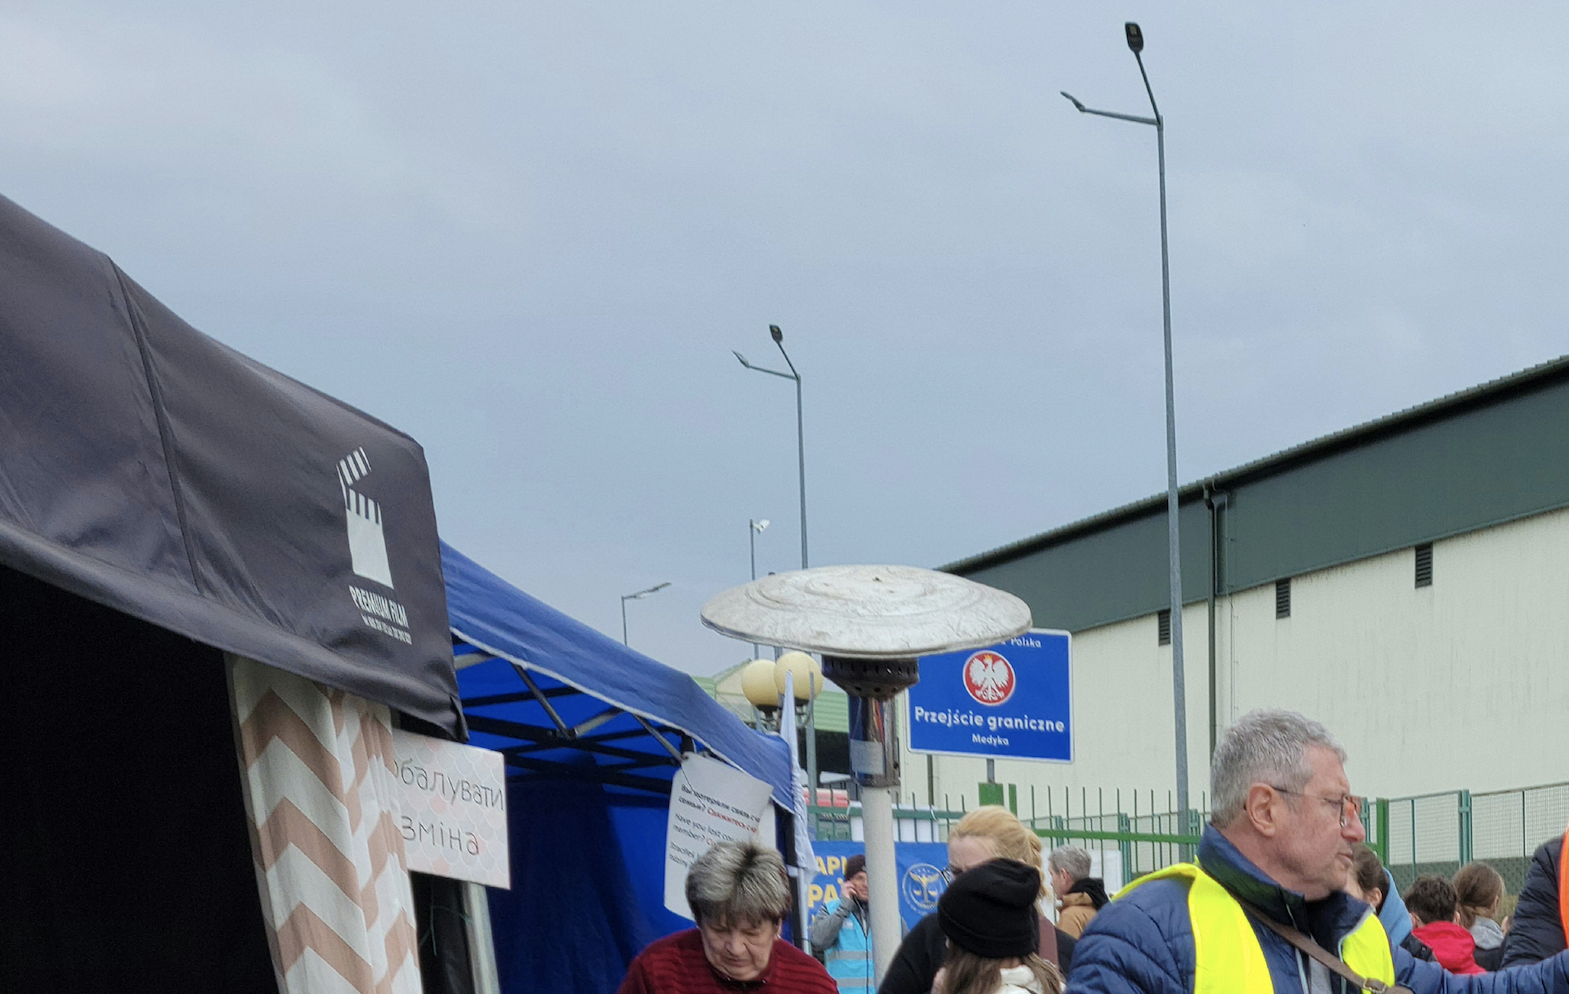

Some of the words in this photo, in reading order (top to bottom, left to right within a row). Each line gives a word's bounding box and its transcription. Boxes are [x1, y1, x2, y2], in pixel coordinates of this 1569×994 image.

[914, 706, 984, 728] Przejście
[986, 714, 1065, 733] graniczne
[972, 733, 1009, 748] Medyka
